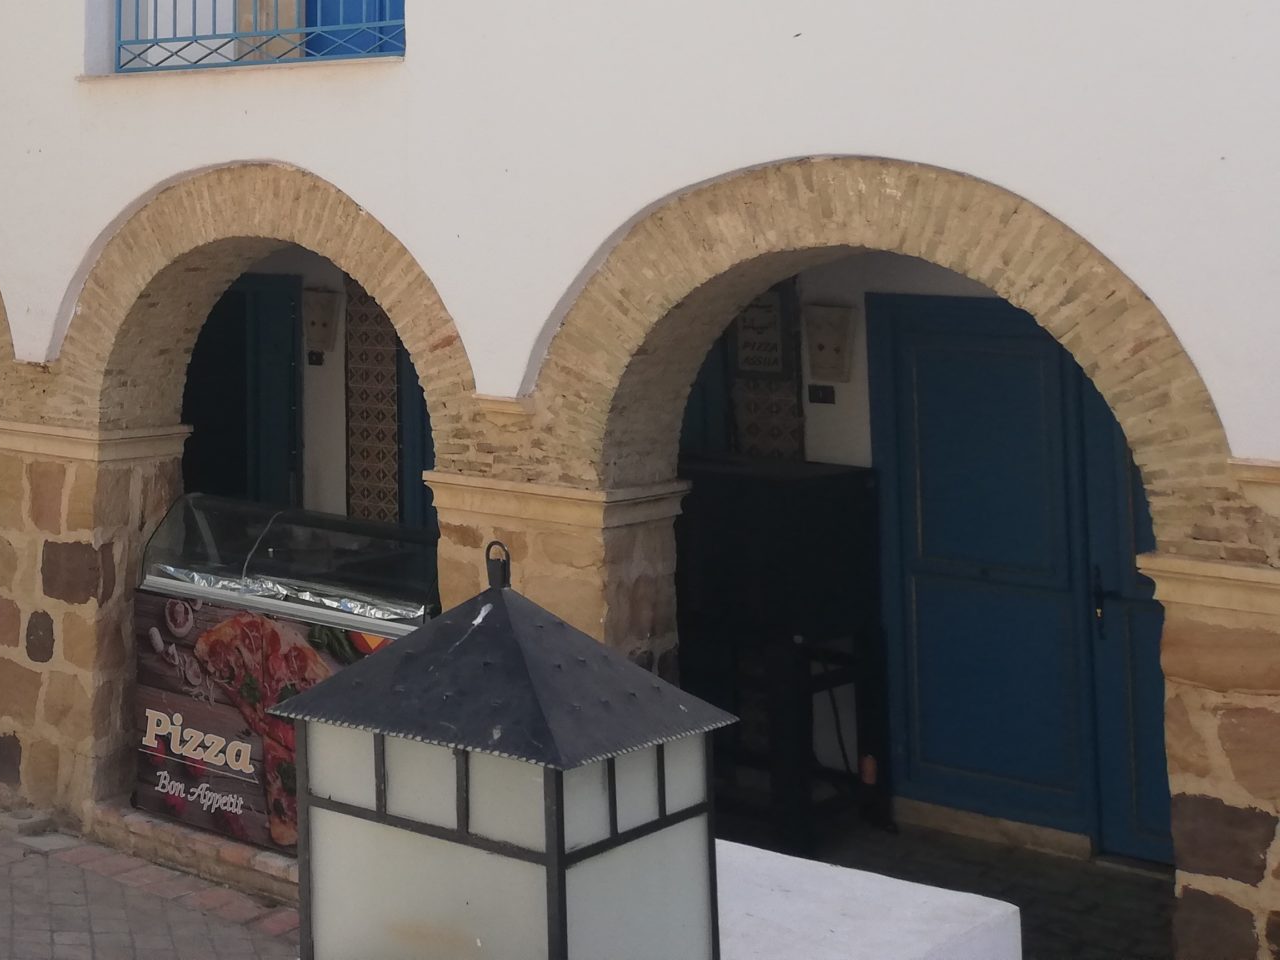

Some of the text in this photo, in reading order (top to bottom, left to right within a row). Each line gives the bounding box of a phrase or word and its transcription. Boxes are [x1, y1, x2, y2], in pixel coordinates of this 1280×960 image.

[142, 708, 255, 774] Pizza
[155, 771, 244, 815] Bon Appetit
